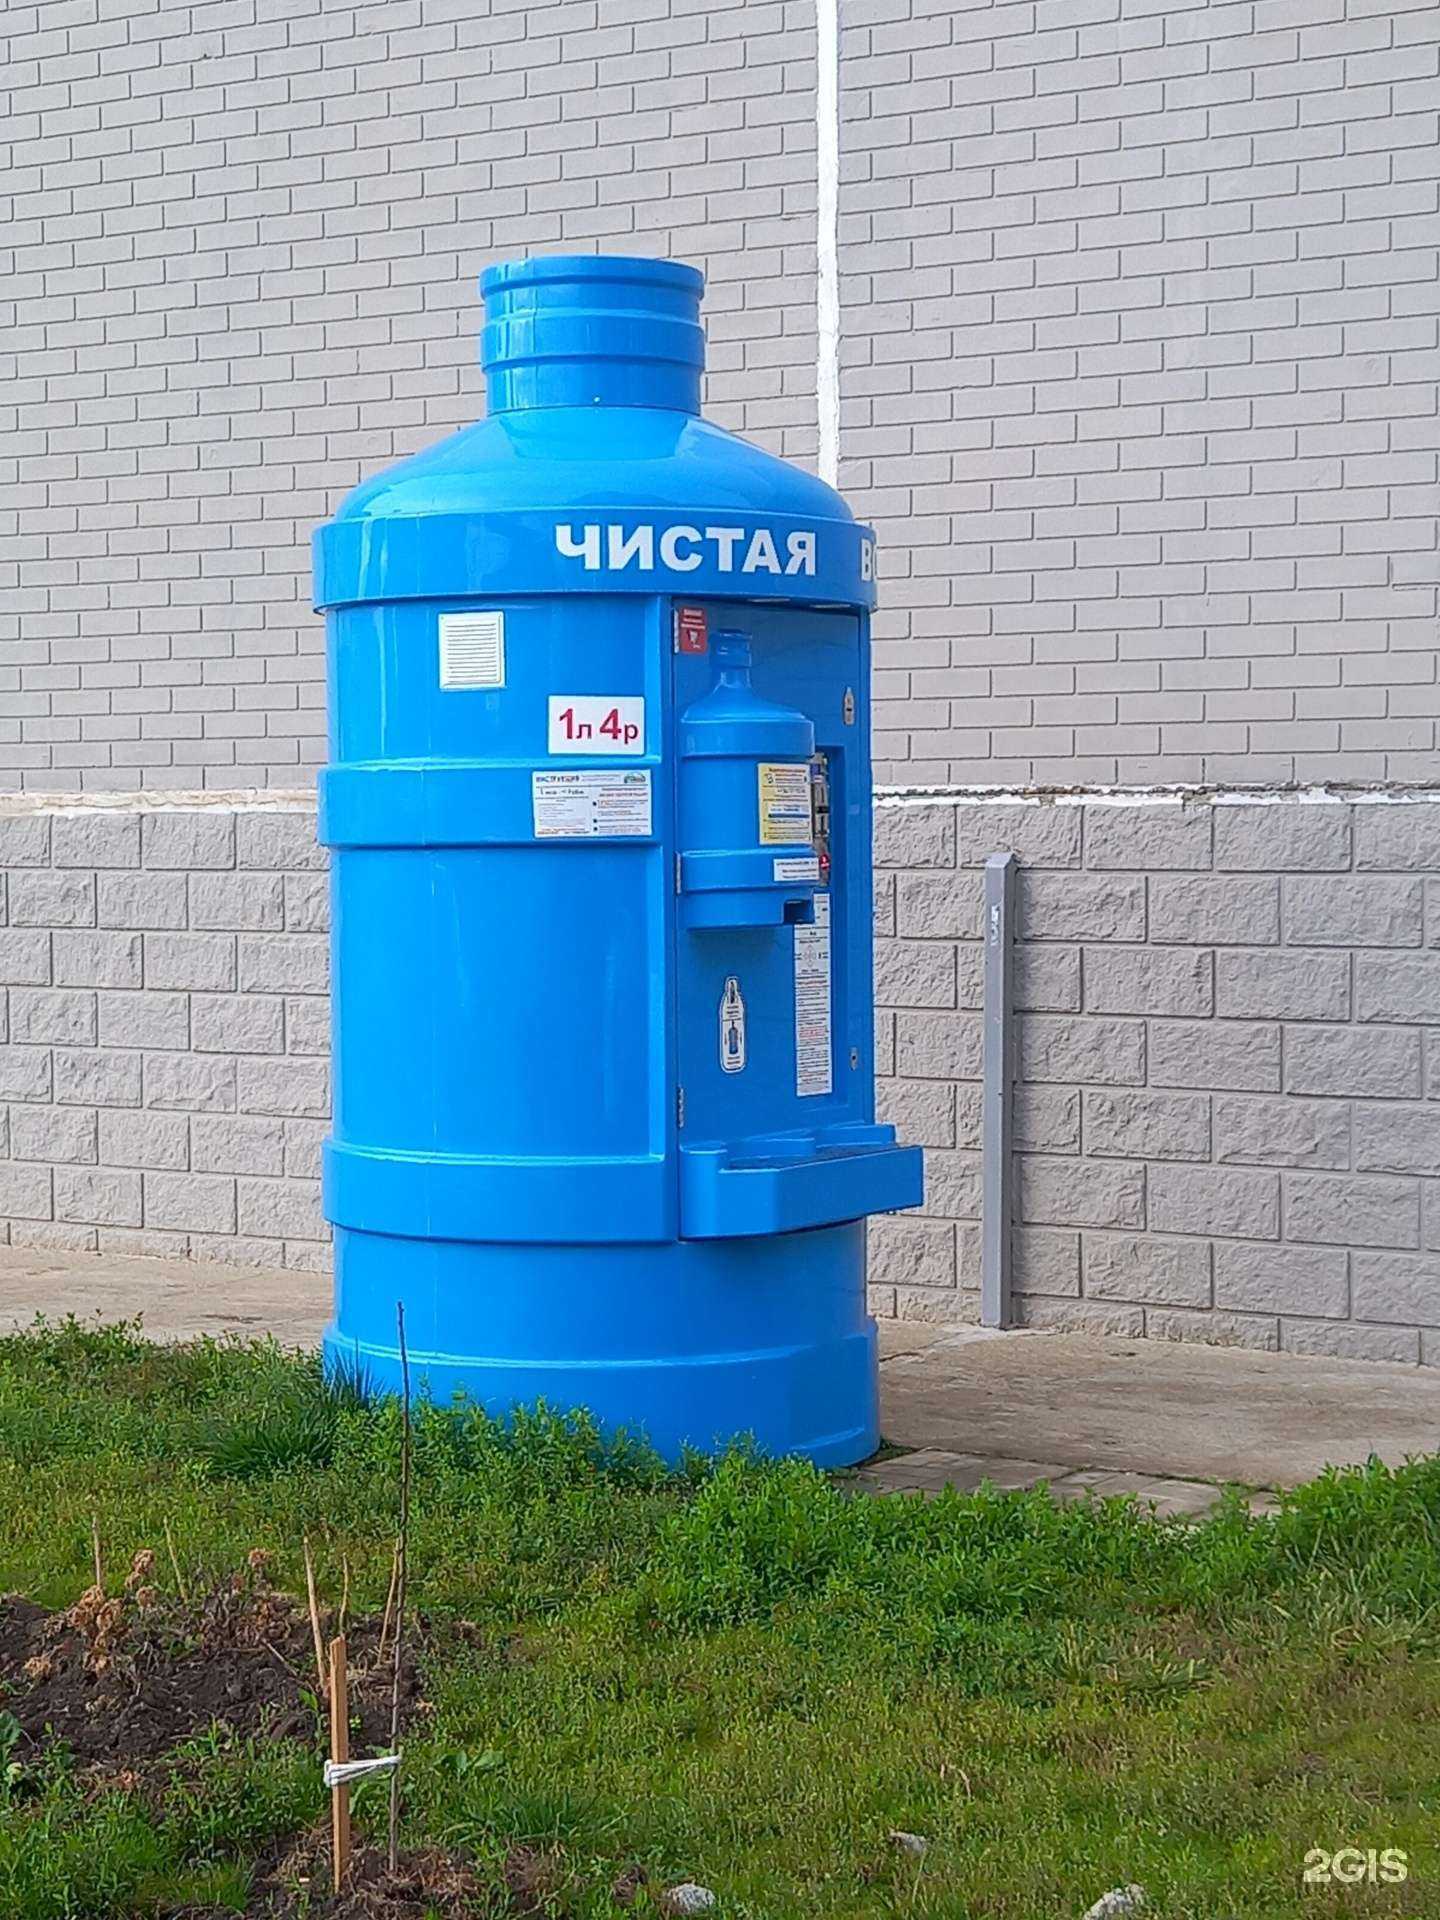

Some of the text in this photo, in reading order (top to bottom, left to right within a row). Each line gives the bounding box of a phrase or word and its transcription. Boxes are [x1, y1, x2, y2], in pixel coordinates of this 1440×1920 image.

[555, 525, 877, 581] ЧИСТАЯ В
[559, 708, 639, 745] 1л 4р
